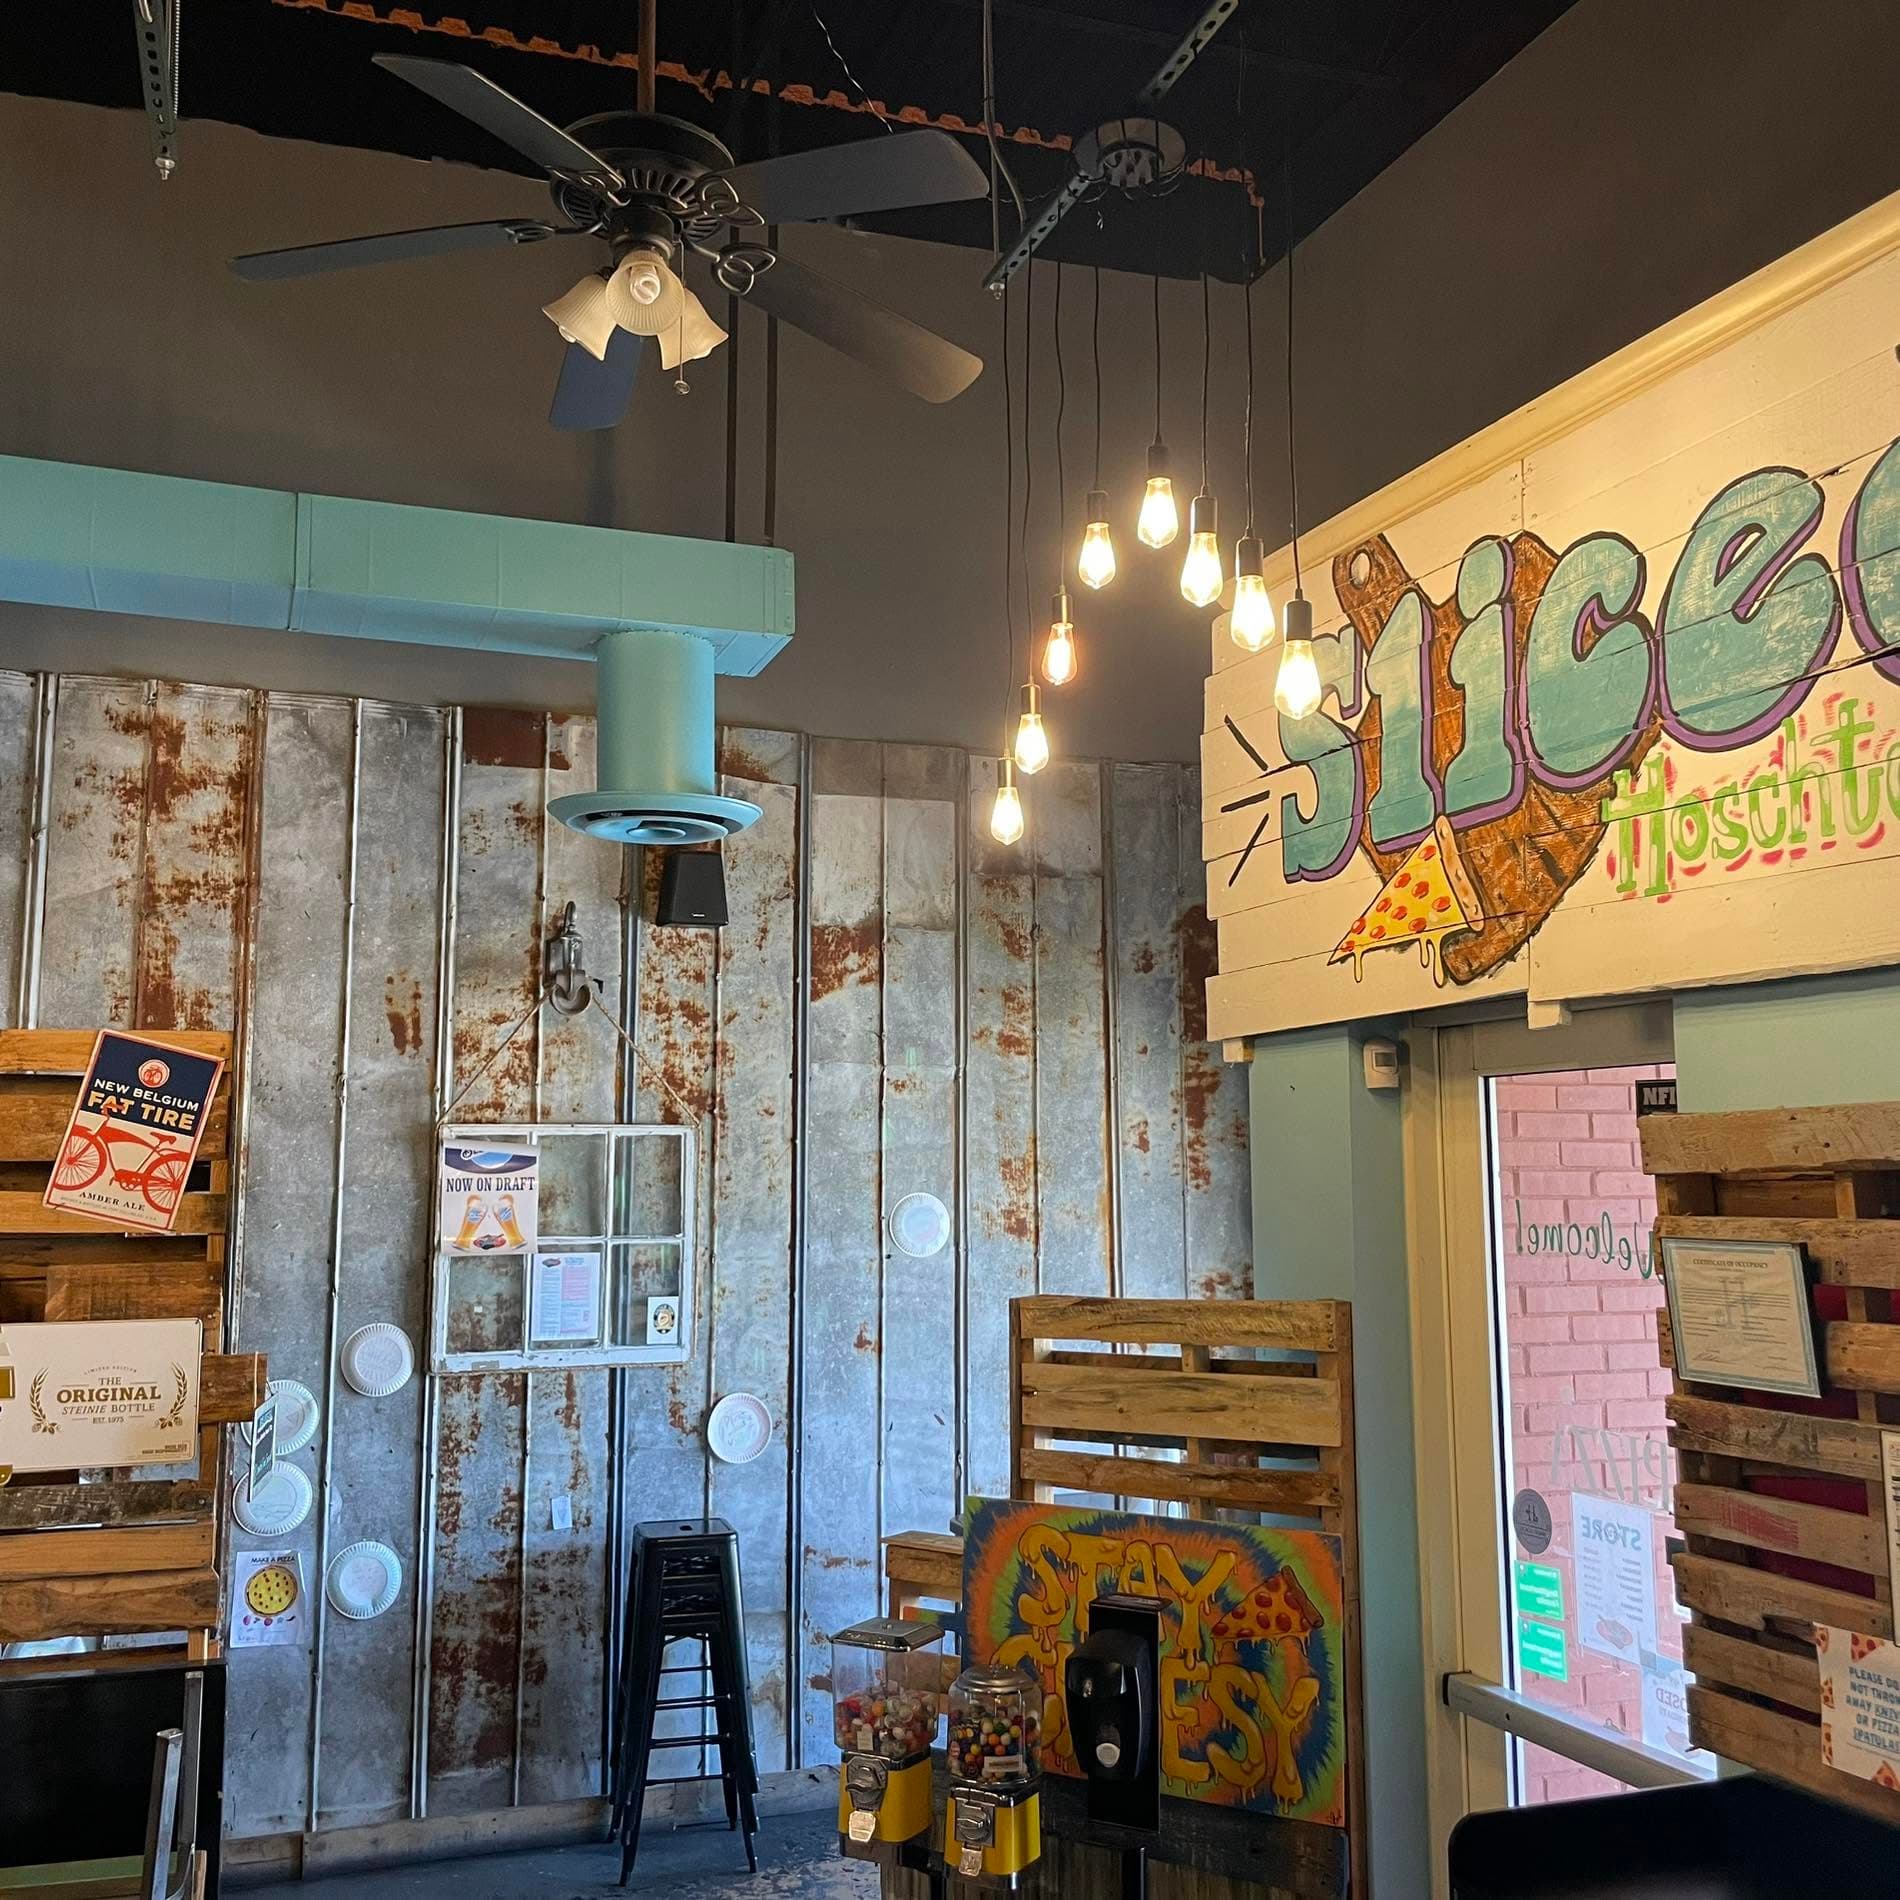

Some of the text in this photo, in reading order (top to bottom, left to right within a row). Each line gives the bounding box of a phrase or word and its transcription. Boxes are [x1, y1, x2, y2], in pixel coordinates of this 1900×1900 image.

[94, 1078, 200, 1112] NEW BELGIUM
[87, 1091, 196, 1131] FAT TIRE
[446, 1176, 535, 1192] NOW ON DRAFT
[79, 1191, 120, 1206] AMBER
[123, 1201, 146, 1212] ALE
[98, 1376, 122, 1386] THE
[56, 1386, 161, 1404] ORIGINAL
[61, 1402, 156, 1415] STEINIE BOTTLE
[1017, 1523, 1238, 1650] STAY
[1848, 1666, 1900, 1691] PLEASE DO
[1850, 1681, 1869, 1697] NOT
[1846, 1695, 1872, 1712] AWAY
[1855, 1713, 1900, 1738] OR PIZZA
